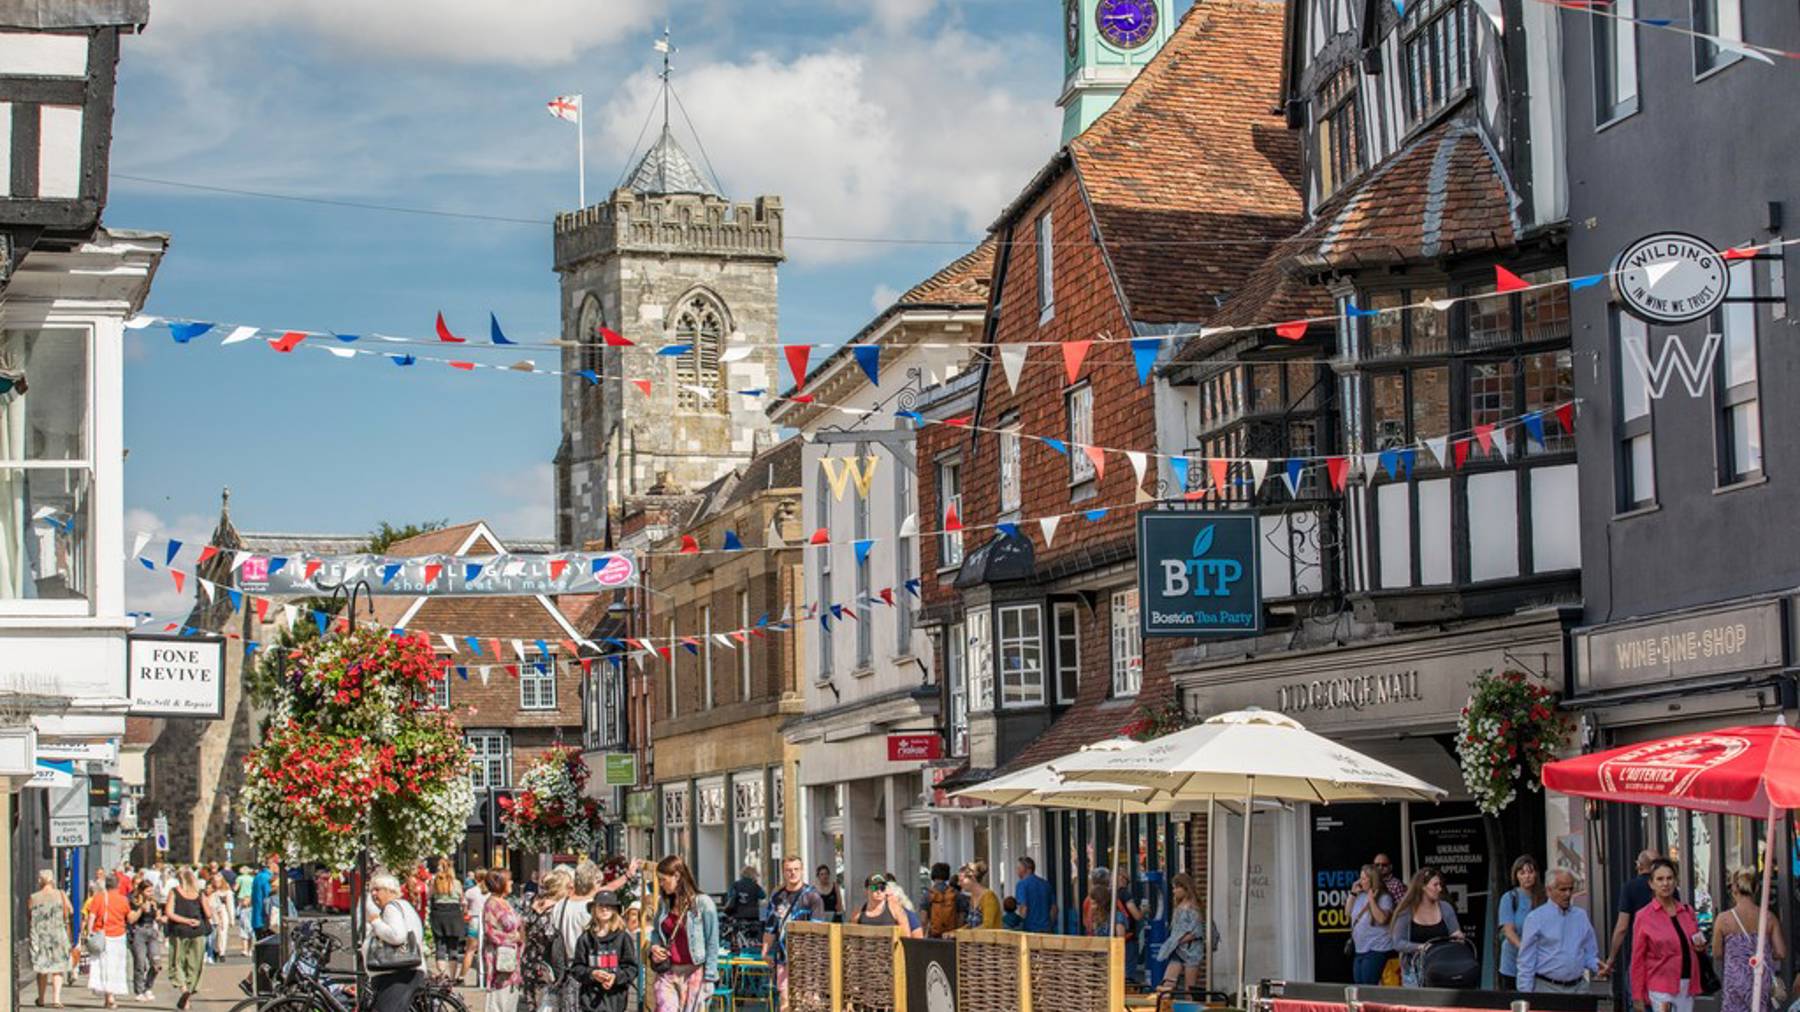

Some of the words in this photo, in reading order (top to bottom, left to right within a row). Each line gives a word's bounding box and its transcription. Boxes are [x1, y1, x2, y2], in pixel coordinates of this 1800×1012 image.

[1631, 244, 1712, 270] WILDING
[1632, 287, 1647, 300] IN
[1645, 294, 1668, 313] WINE
[1671, 299, 1686, 312] WE
[1687, 285, 1714, 309] TRUST
[1624, 333, 1722, 399] W
[817, 455, 880, 502] W
[1160, 559, 1242, 597] BTP
[1152, 611, 1195, 624] Boston
[1194, 611, 1218, 624] Tea
[1220, 611, 1252, 626] Party
[1616, 638, 1657, 669] WINE
[1661, 631, 1697, 664] DINE
[1702, 623, 1747, 657] SHOP
[153, 649, 199, 663] FONE
[140, 666, 212, 682] REVIVE
[1309, 675, 1375, 711] GEORGE
[1376, 670, 1423, 705] MALL
[184, 700, 213, 709] Repair
[55, 834, 84, 844] ENDS
[1436, 844, 1471, 854] UKRAINE
[1424, 854, 1483, 864] HUMANITARIAN
[1440, 864, 1468, 874] APPEAL
